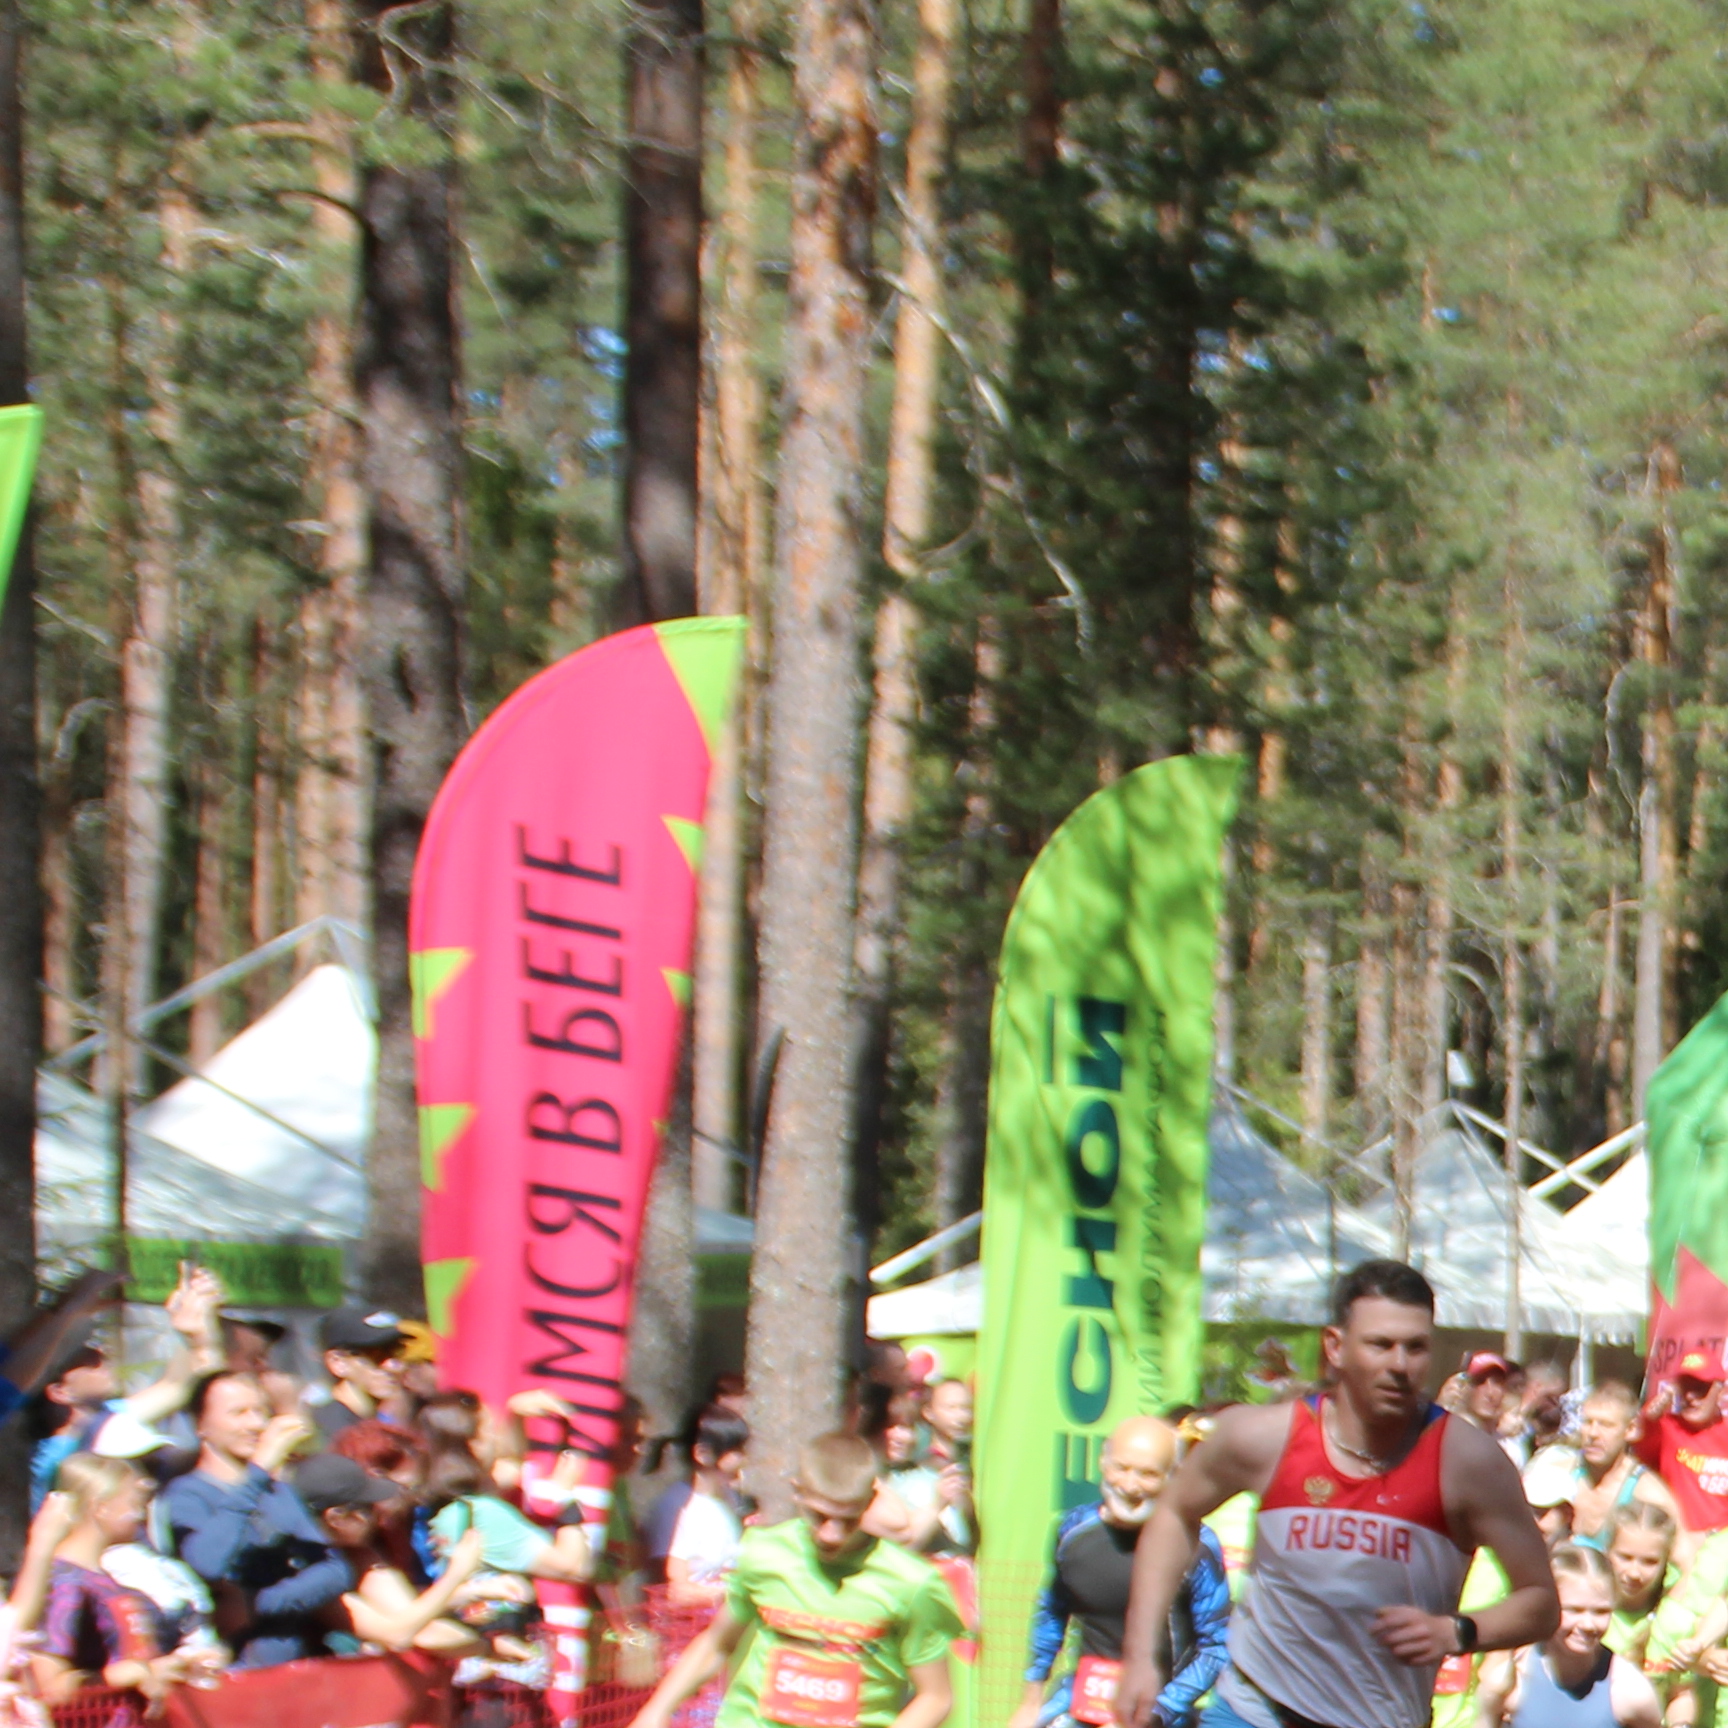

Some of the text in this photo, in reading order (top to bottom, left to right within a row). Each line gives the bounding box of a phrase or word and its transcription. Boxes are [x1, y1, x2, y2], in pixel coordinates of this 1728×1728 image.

[514, 822, 625, 1065] БЕГЕ
[1008, 992, 1126, 1512] ЕСНОЙ
[1286, 1514, 1413, 1564] RUSSIA
[775, 1669, 848, 1702] 5469
